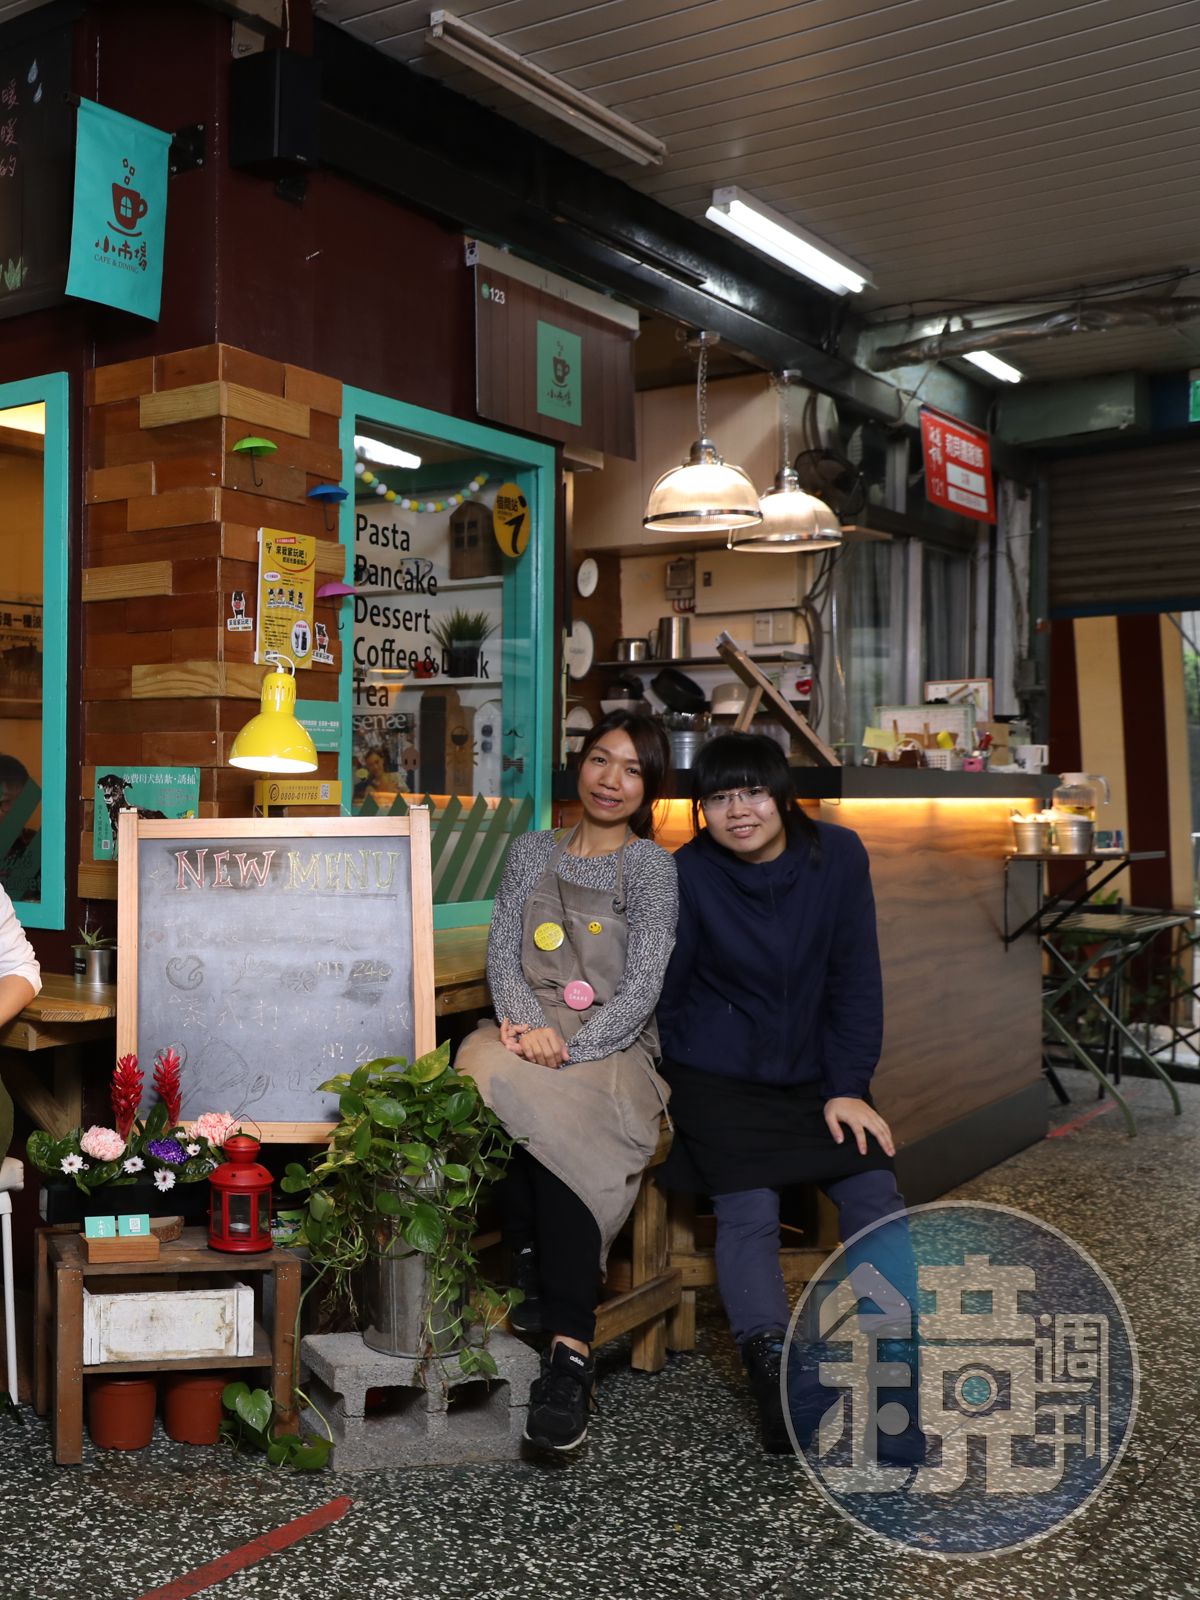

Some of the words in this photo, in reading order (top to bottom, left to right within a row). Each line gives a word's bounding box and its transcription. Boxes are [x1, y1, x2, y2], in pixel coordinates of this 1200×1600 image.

[94, 235, 148, 272] 小市場
[94, 253, 112, 266] CAFE
[490, 287, 505, 304] 123
[356, 513, 410, 552] Pasta
[355, 554, 438, 597] Pancake
[354, 595, 431, 634] Dessert
[353, 636, 419, 672] Coffee
[441, 647, 490, 679] Dnk
[353, 677, 389, 707] Tea
[175, 848, 276, 891] NEW
[283, 849, 401, 891] MENU
